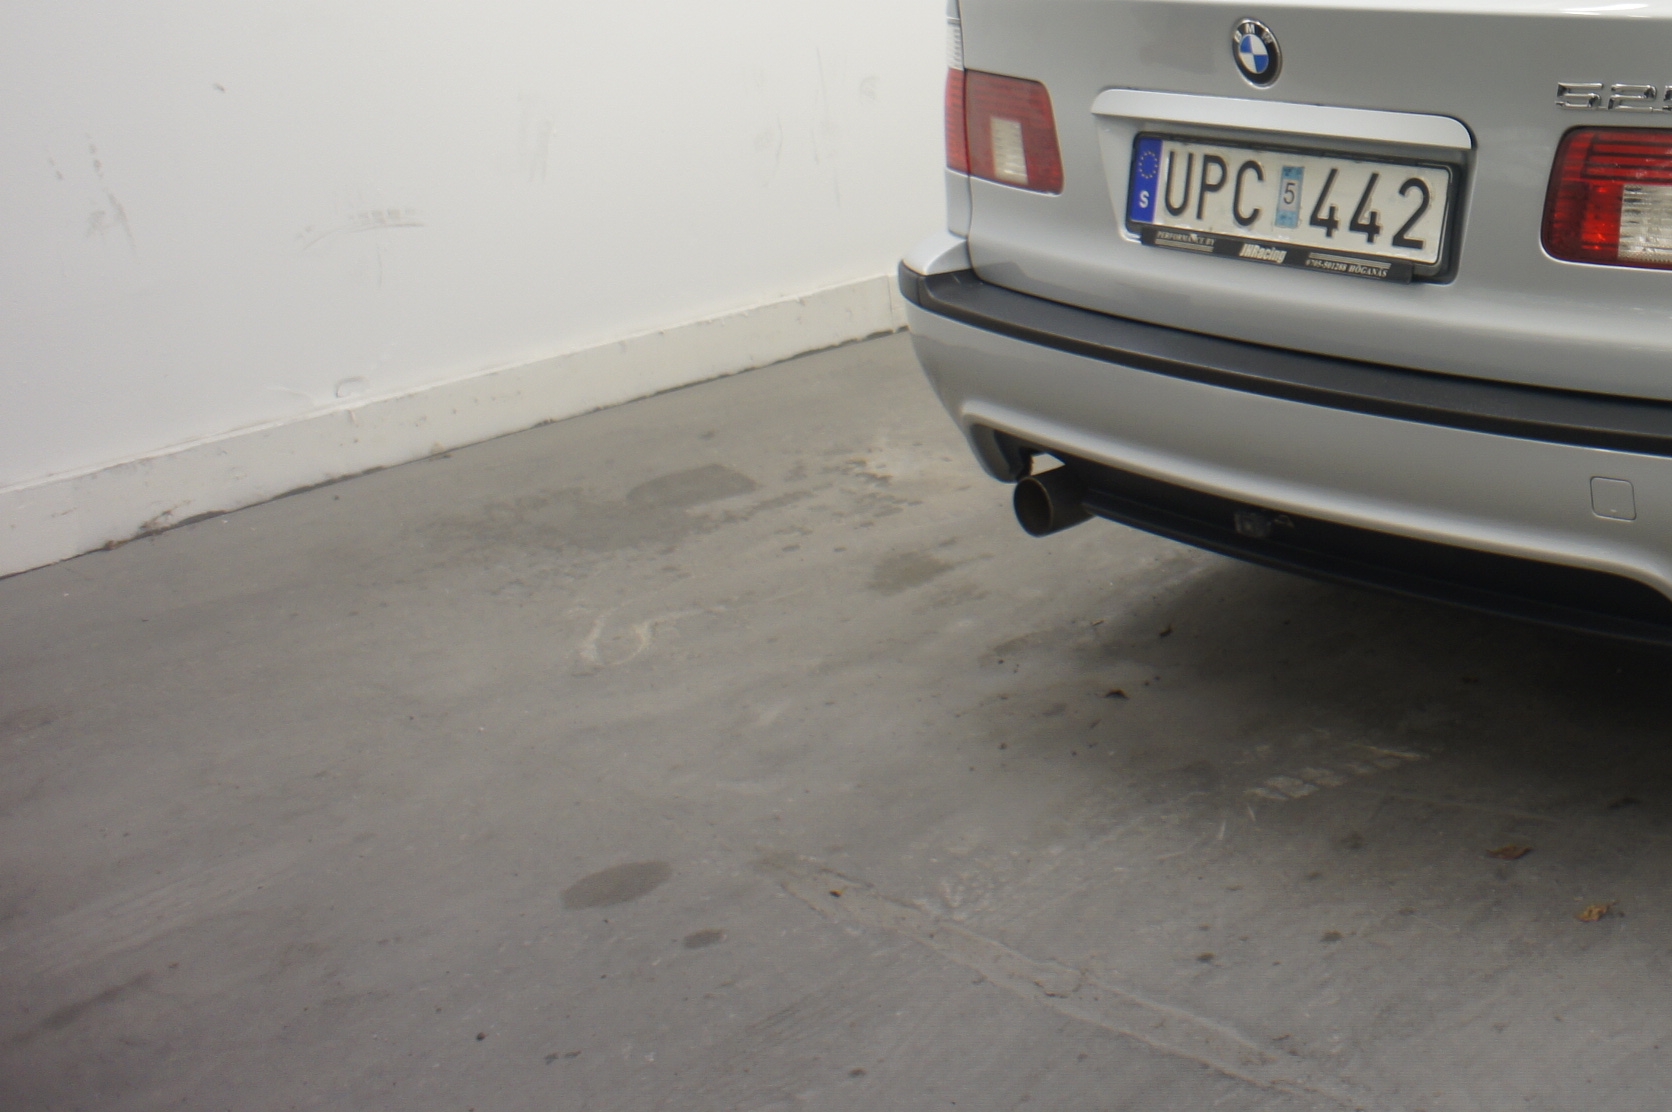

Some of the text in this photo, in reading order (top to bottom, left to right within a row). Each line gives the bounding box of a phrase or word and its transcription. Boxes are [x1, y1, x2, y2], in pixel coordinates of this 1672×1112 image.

[1138, 189, 1150, 209] S
[1164, 150, 1432, 251] UPC 442
